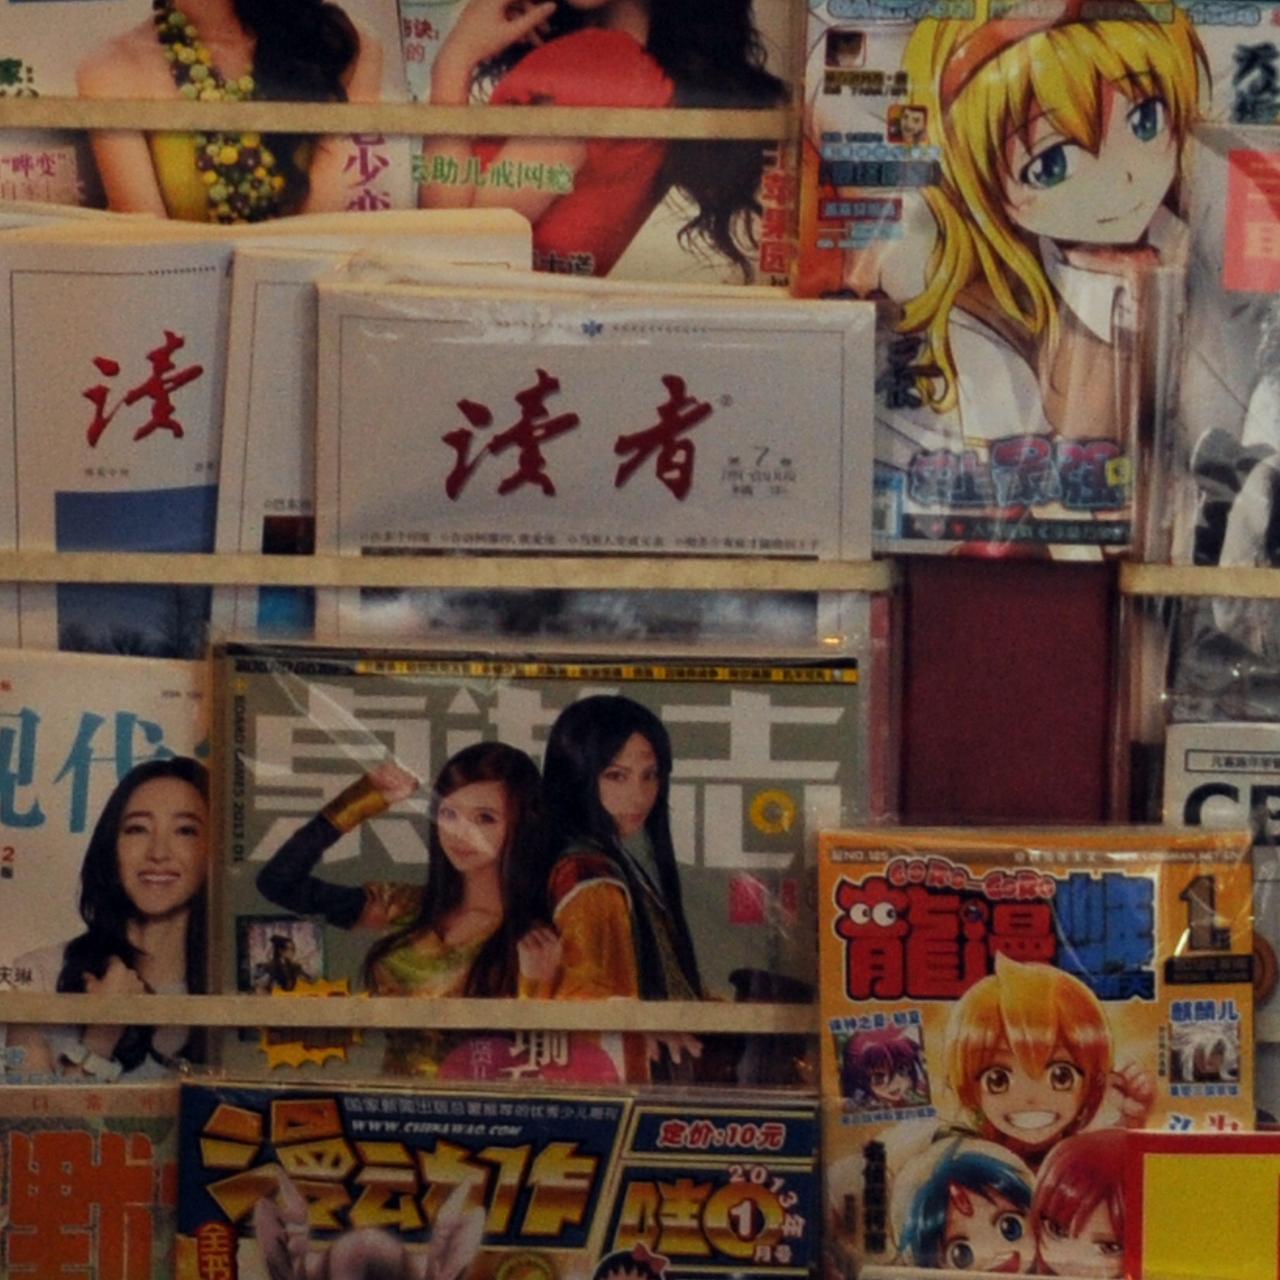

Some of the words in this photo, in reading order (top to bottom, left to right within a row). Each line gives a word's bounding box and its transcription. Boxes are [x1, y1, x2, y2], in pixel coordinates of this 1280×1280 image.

[441, 368, 714, 502] 读者
[657, 1120, 787, 1149] 定价:10元
